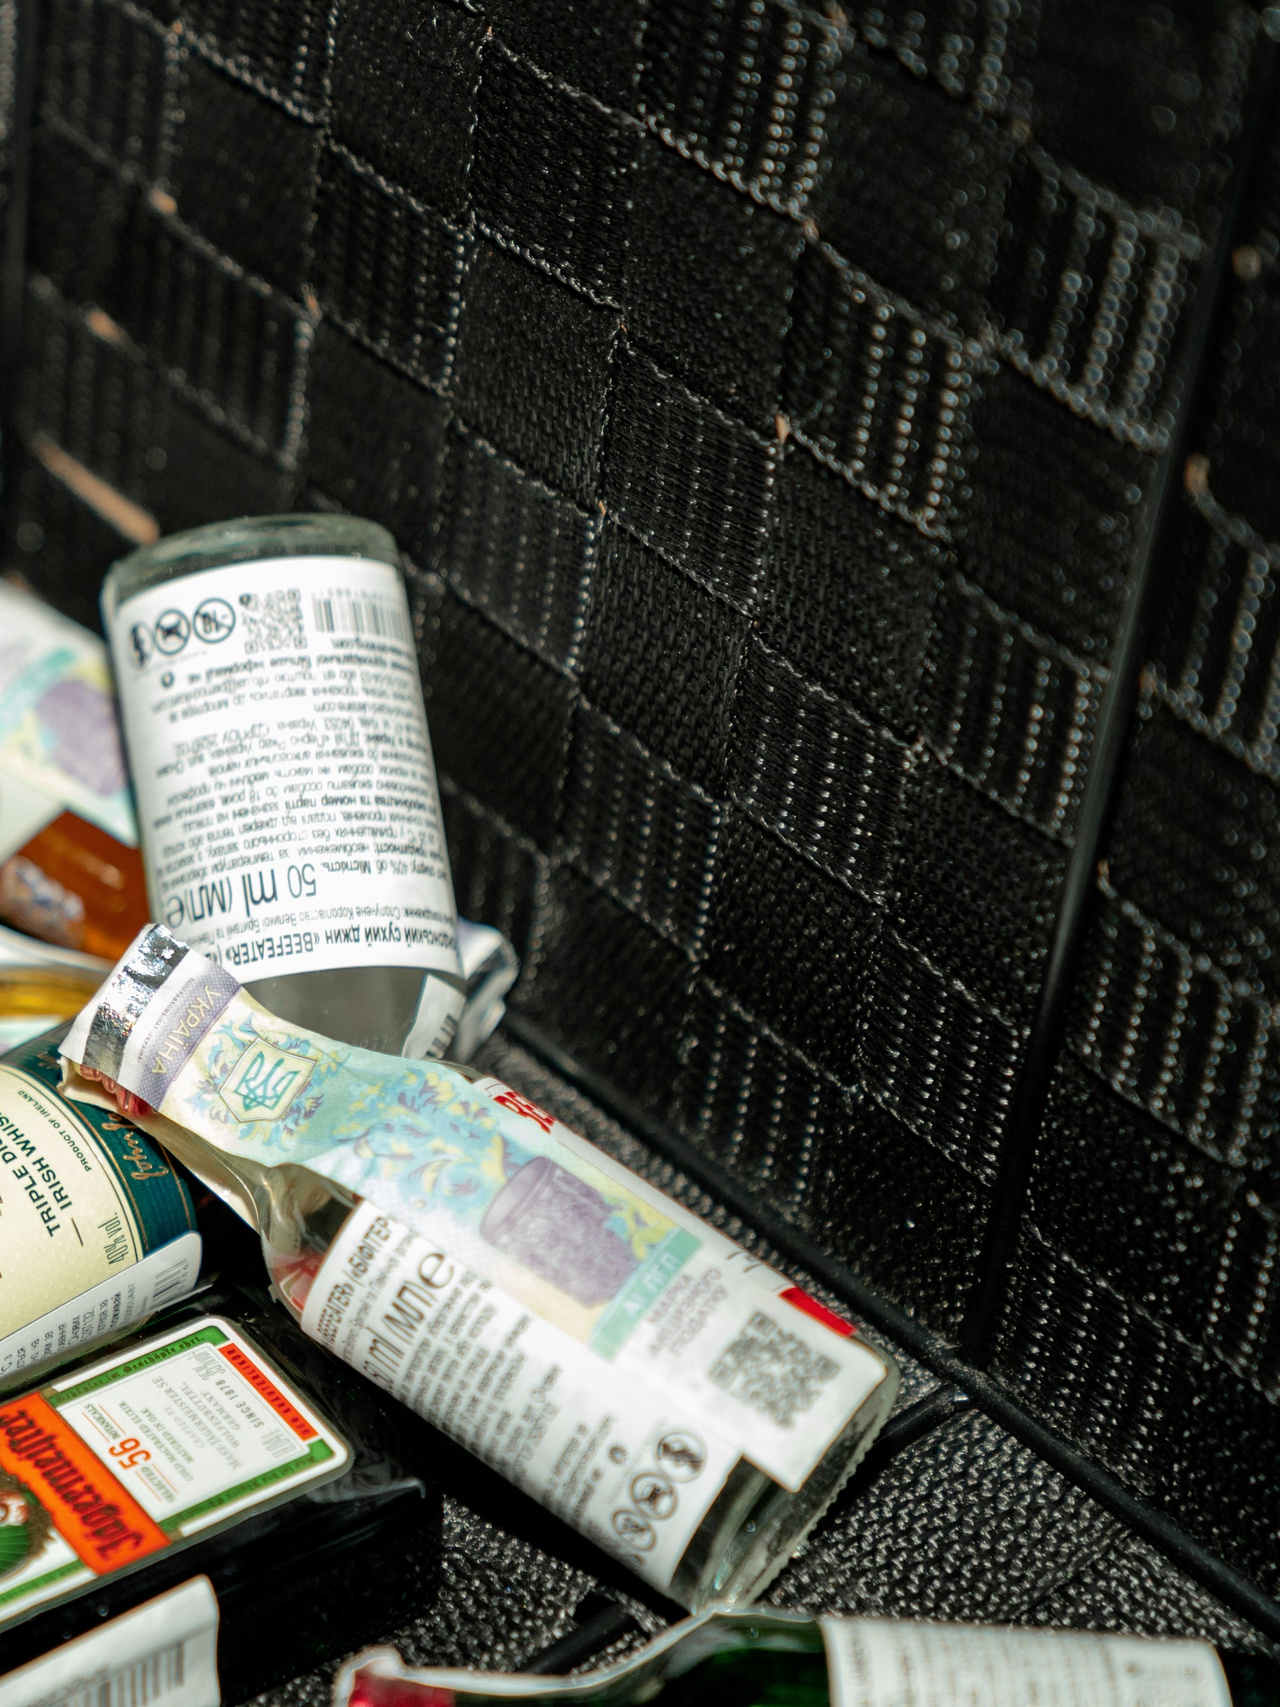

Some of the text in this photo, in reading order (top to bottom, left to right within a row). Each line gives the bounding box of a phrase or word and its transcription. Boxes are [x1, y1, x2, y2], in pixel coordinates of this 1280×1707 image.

[320, 792, 356, 806] номер
[240, 868, 279, 918] ml
[285, 861, 318, 899] 50
[224, 930, 321, 967] «BEEFEATER»
[324, 924, 361, 944] джин
[363, 920, 401, 947] сухий
[148, 984, 222, 1077] УКРАЇНА
[15, 1087, 93, 1173] PRODUCT OF IRELAND
[10, 1161, 64, 1238] TRIPLE
[30, 1154, 74, 1213] IRISH
[98, 1210, 131, 1268] 40% vol.
[354, 1325, 407, 1374] ml
[151, 1373, 168, 1391] SE
[214, 1376, 239, 1402] 1878
[225, 1346, 292, 1415] KRÄUTERLIKÖR
[162, 1403, 206, 1450] CRAFTED BY
[200, 1388, 241, 1432] GERMANY
[234, 1398, 264, 1430] SINCE
[83, 1401, 177, 1504] SELECTED 56 BOTANICALS
[117, 1399, 194, 1483] COLD MACERATED ELIXIR
[140, 1405, 195, 1465] MATURED IN OAK
